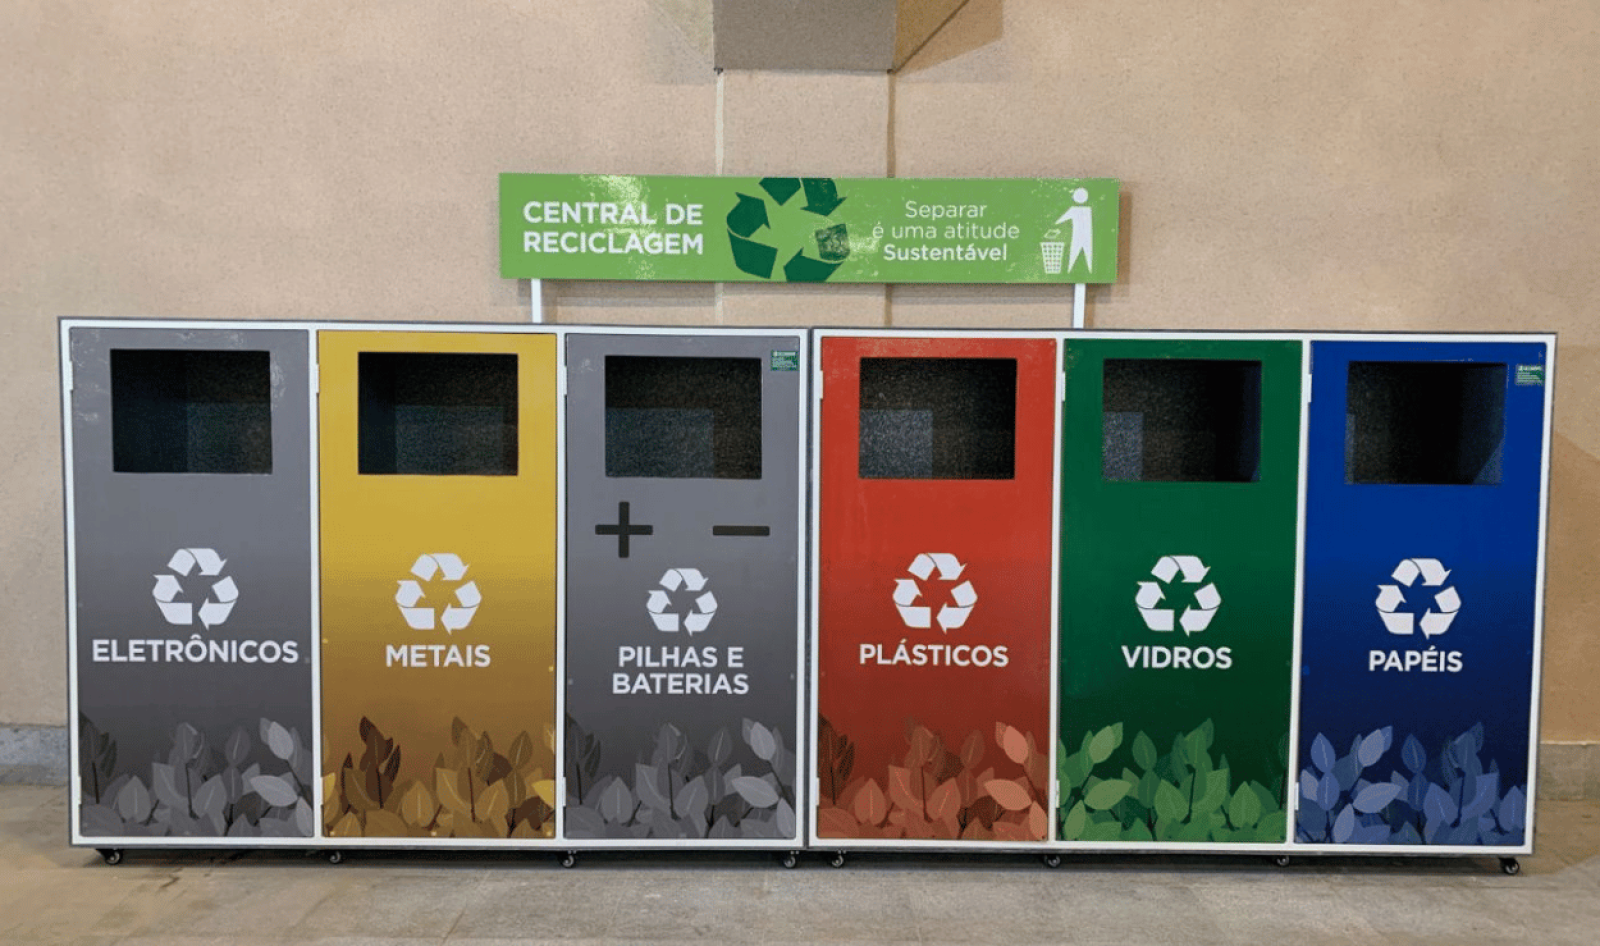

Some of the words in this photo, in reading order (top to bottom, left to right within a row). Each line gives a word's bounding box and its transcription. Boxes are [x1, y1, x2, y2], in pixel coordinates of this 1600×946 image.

[523, 201, 657, 225] CENTRAL
[665, 203, 704, 225] DE
[905, 200, 987, 221] Separar
[872, 221, 884, 239] é
[891, 226, 938, 239] uma
[944, 222, 1020, 239] atitude
[523, 231, 704, 255] RECICLAGEM
[883, 243, 1008, 261] Sustentável
[92, 634, 299, 663] ELETRÔNICOS
[385, 644, 491, 668] METAIS
[618, 646, 718, 668] PILHAS
[728, 647, 744, 667] E
[859, 639, 1010, 667] PLÁSTICOS
[1121, 645, 1233, 669] VIDROS
[1368, 646, 1463, 672] PAPÉIS
[612, 673, 750, 695] BATERIAS
